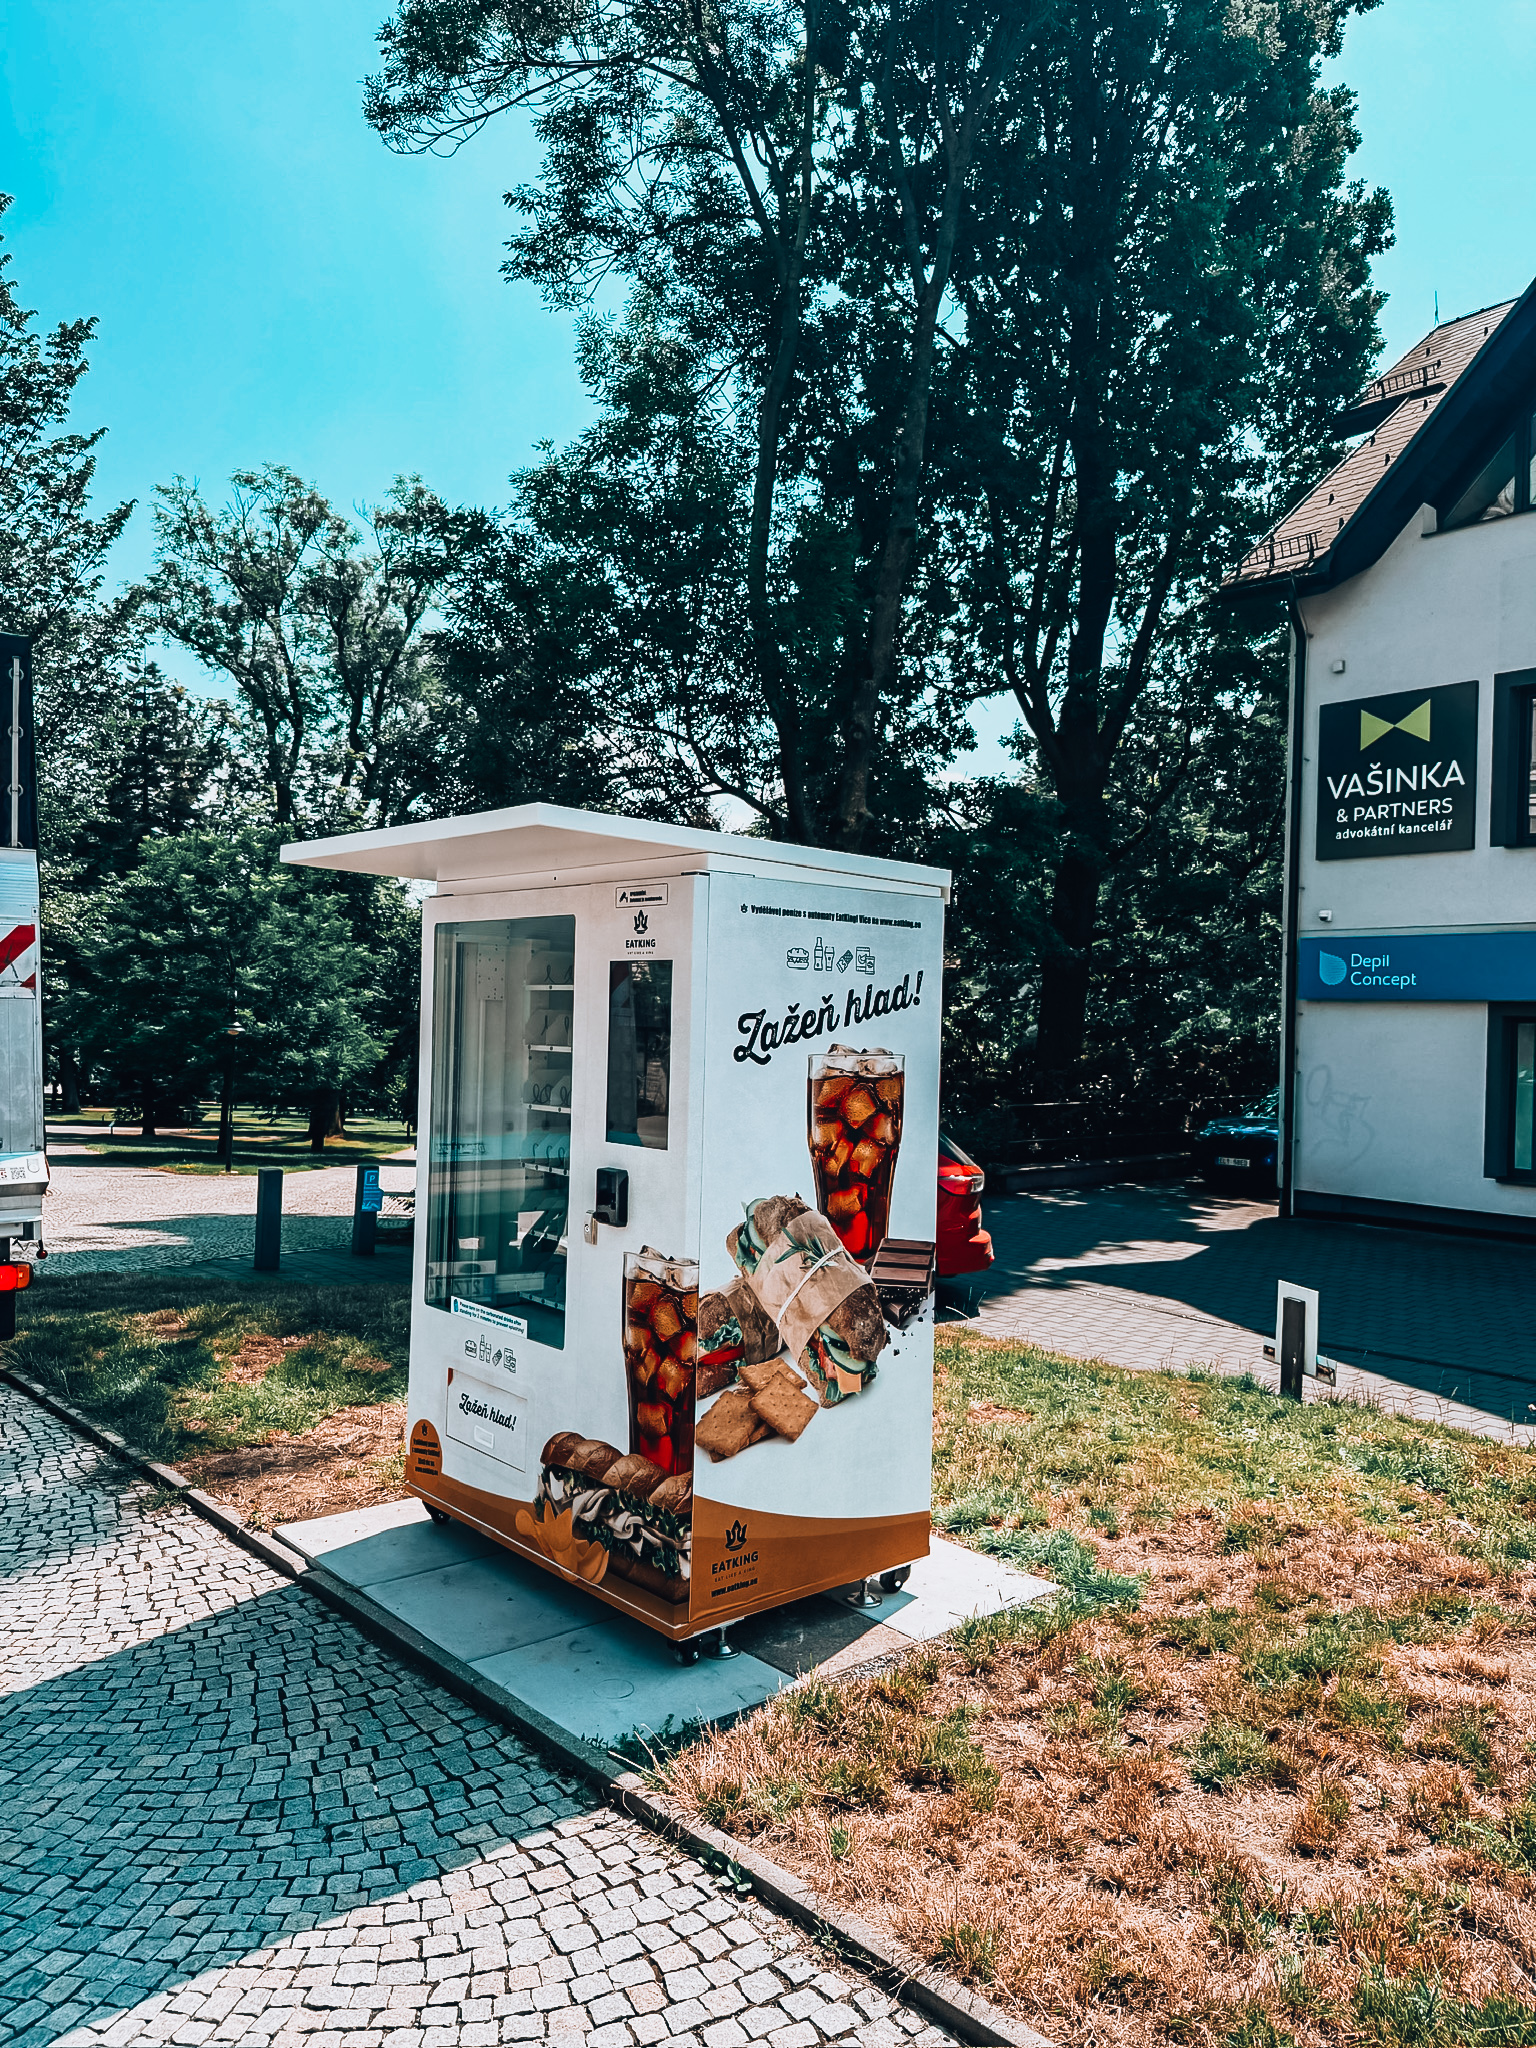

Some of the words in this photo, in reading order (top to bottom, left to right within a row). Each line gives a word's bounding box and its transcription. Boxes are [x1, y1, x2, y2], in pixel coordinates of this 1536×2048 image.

[1327, 760, 1465, 800] VAŠINKA
[1336, 808, 1348, 823] &
[1354, 798, 1453, 821] PARTNERS
[1336, 824, 1395, 840] advokátní
[1399, 818, 1453, 834] kancelář
[626, 939, 656, 949] EATKING
[1350, 953, 1390, 972] Depil
[1350, 971, 1417, 989] Concept
[733, 994, 840, 1065] Zažeň
[843, 970, 924, 1028] hlad!
[459, 1393, 489, 1419] Zažeň
[489, 1407, 517, 1431] hlad!
[712, 1551, 759, 1575] EATKING
